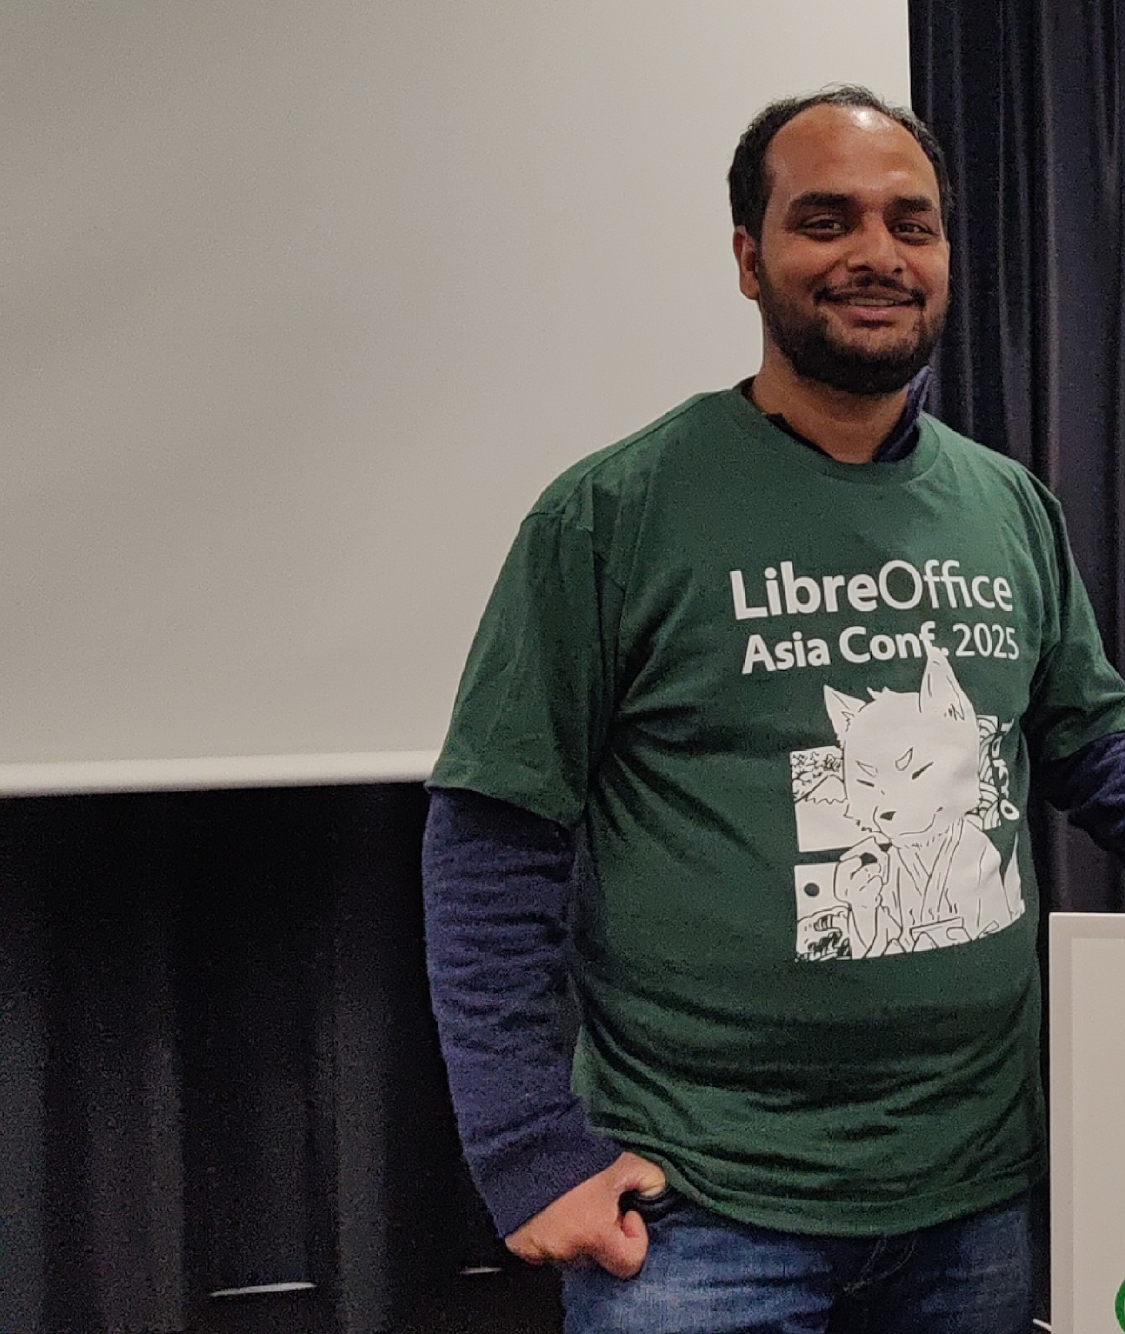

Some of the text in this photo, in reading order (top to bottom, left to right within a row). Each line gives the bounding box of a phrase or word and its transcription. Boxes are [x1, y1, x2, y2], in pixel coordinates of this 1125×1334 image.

[729, 558, 1014, 621] LibreOffice
[741, 620, 1020, 675] Asia Conf. 2025
